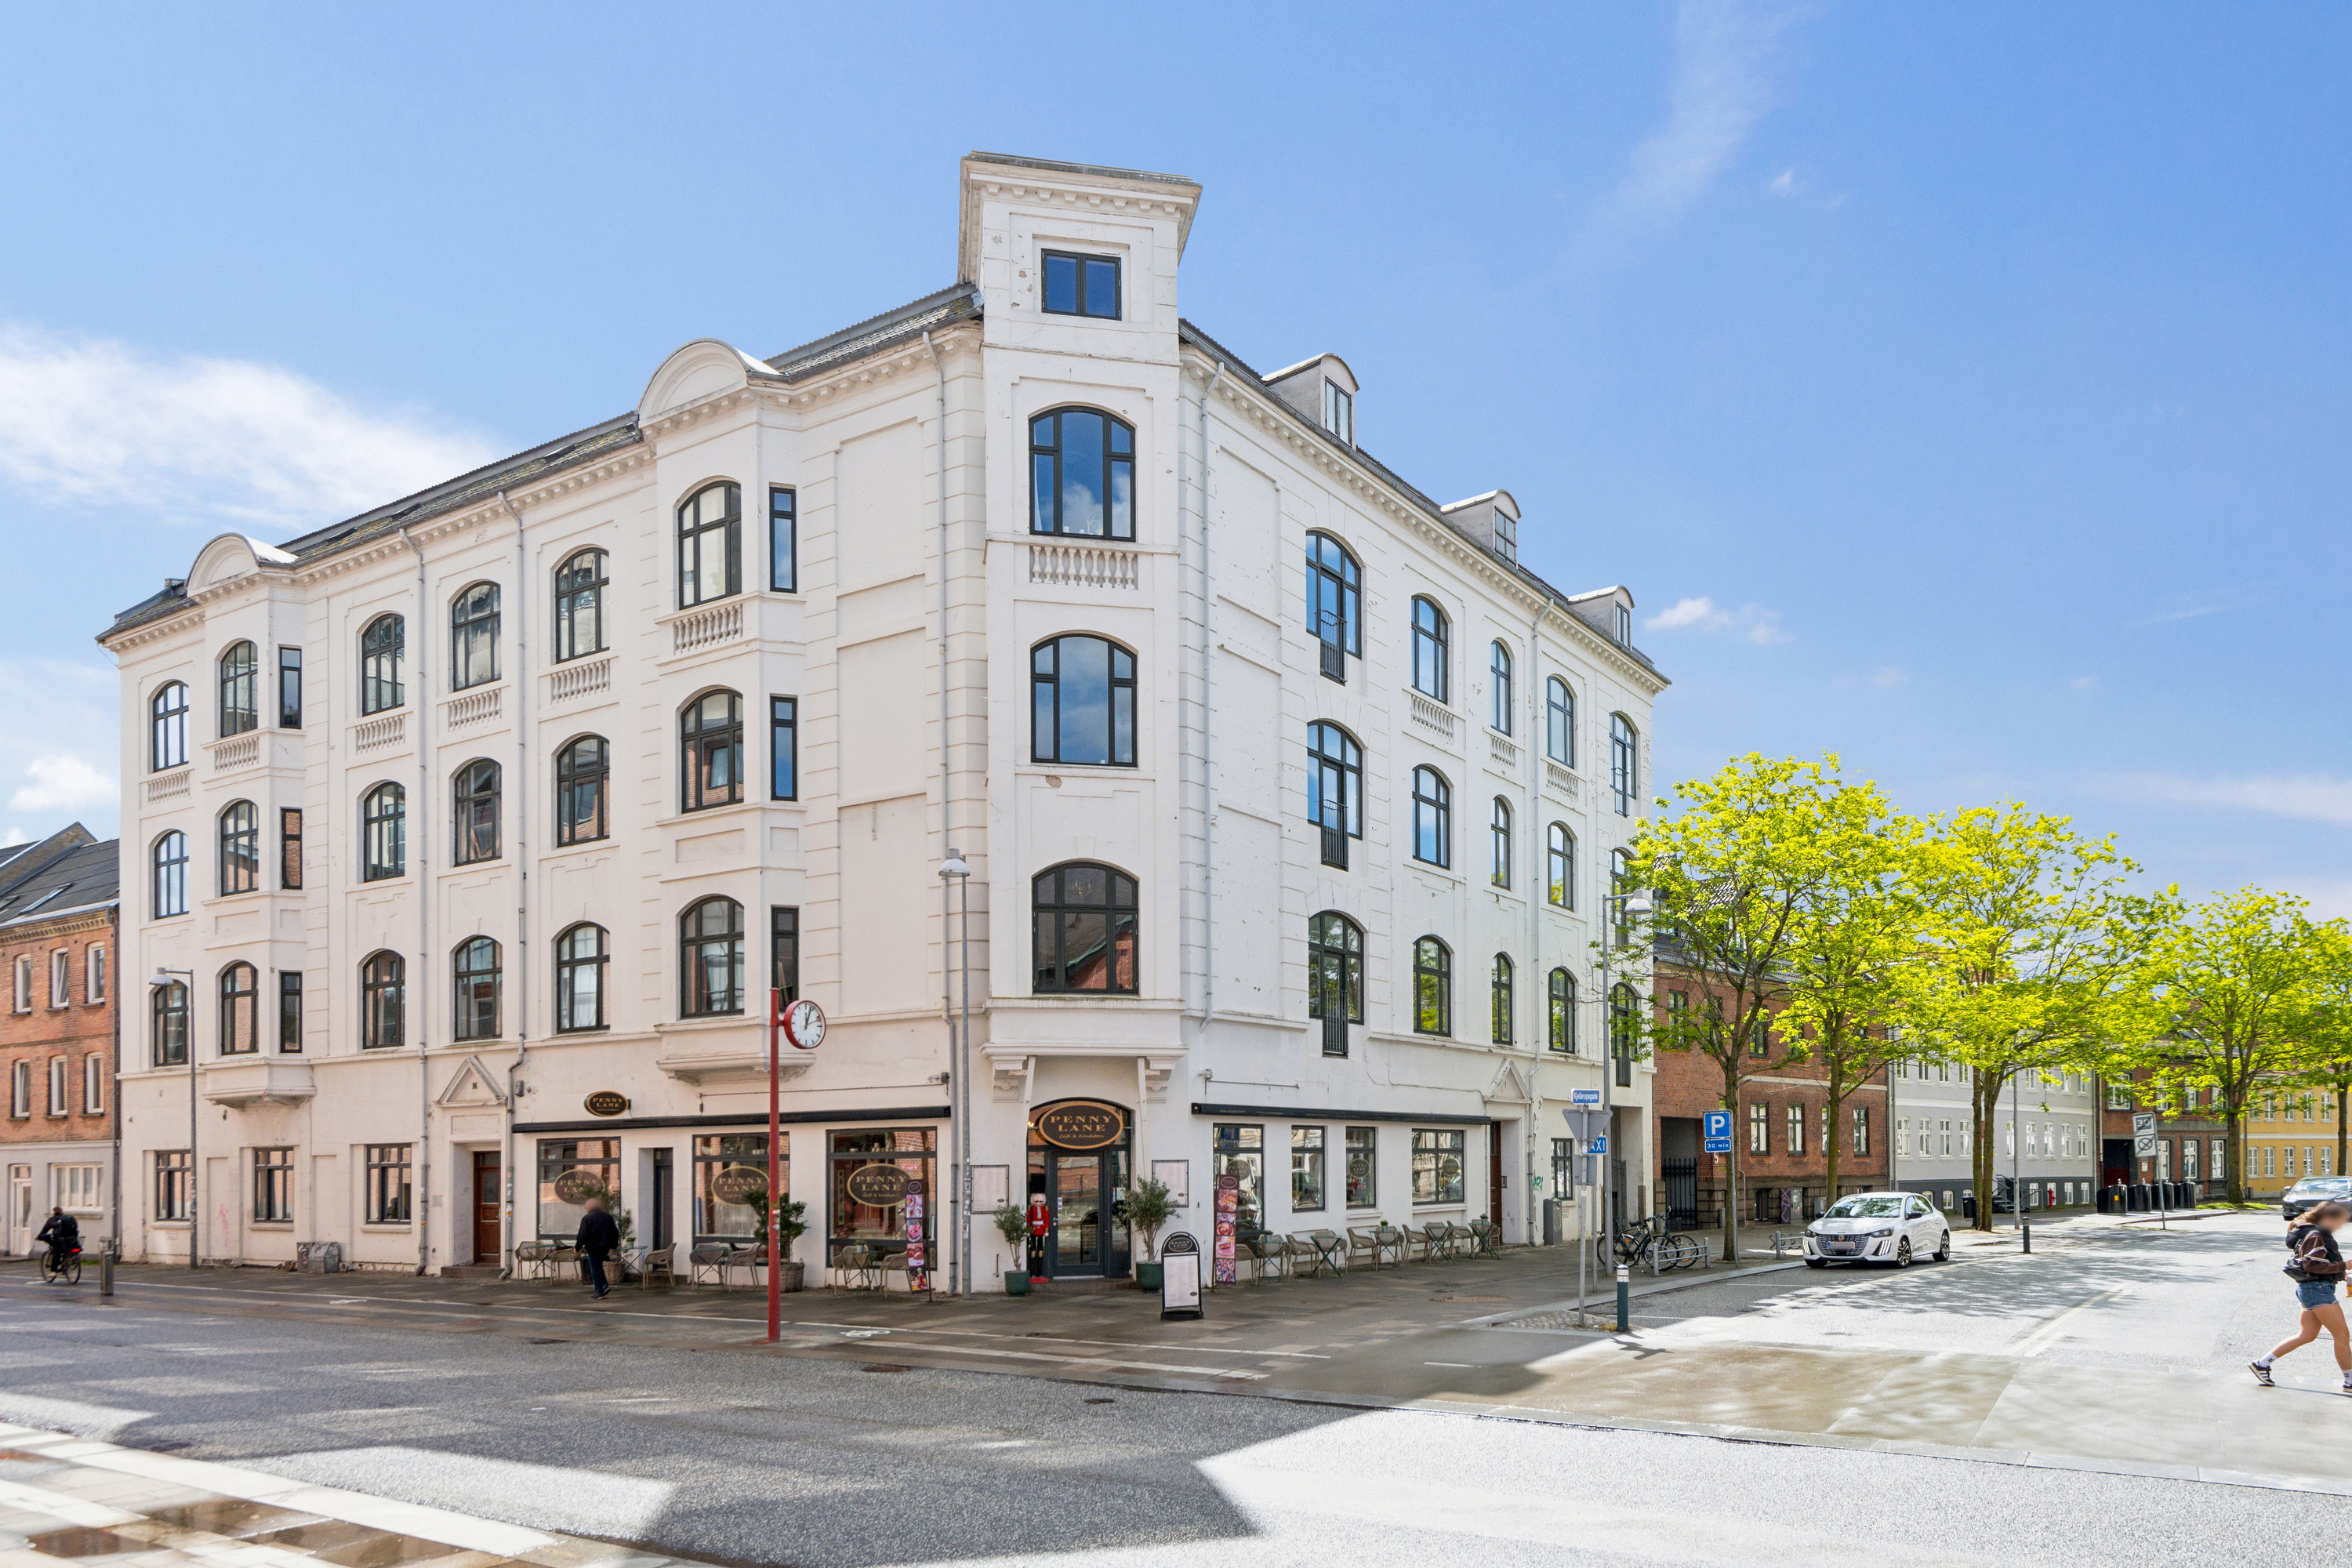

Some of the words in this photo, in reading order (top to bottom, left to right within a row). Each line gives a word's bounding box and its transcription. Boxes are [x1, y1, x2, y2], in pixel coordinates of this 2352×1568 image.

[1711, 1115, 1725, 1135] P
[2136, 1118, 2151, 1127] 30
[1589, 1139, 1606, 1152] AXI
